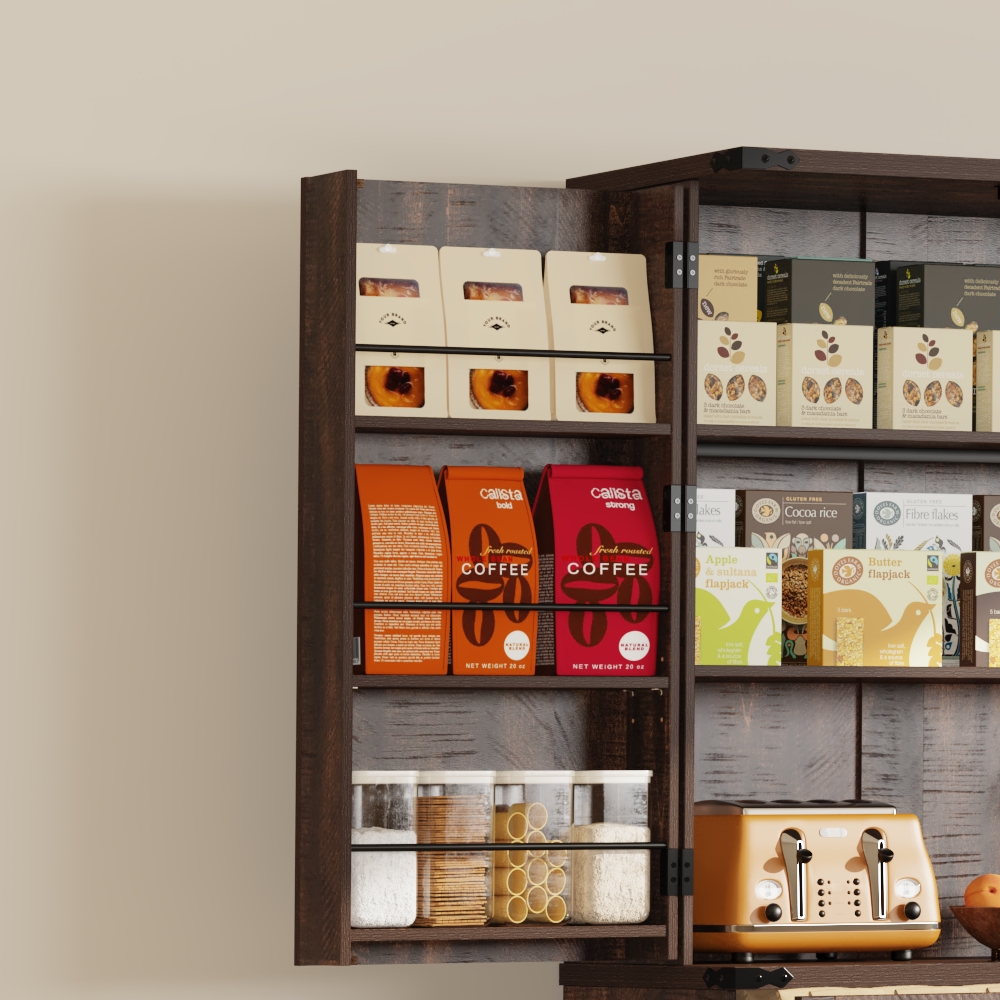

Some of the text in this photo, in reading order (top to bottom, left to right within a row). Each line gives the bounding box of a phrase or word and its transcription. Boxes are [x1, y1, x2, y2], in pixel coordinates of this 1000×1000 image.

[701, 301, 713, 316] new
[820, 305, 832, 320] new
[379, 312, 407, 325] YOUR BRAND
[483, 316, 511, 328] YOUR BRAND
[589, 319, 617, 332] YOUR BRAND
[703, 363, 768, 373] dorset cereals
[801, 366, 865, 376] dorset cereals
[902, 369, 965, 380] dorset cereals
[480, 488, 524, 501] Calista
[590, 487, 644, 501] Calista
[495, 501, 514, 510] bold
[605, 501, 636, 512] strong
[784, 506, 838, 518] Cocoa rice
[906, 508, 959, 520] Fibre flakes
[876, 514, 899, 526] ORGANIC
[480, 545, 533, 556] fresh roasted
[589, 545, 654, 557] fresh roasted
[705, 555, 738, 566] Apple
[868, 557, 902, 567] Butter
[461, 562, 529, 576] COFFEE
[567, 562, 649, 576] COFFEE
[705, 567, 757, 577] & sultana
[836, 572, 862, 585] ORGANIC
[868, 570, 911, 581] flapjack
[705, 579, 749, 590] flapjack
